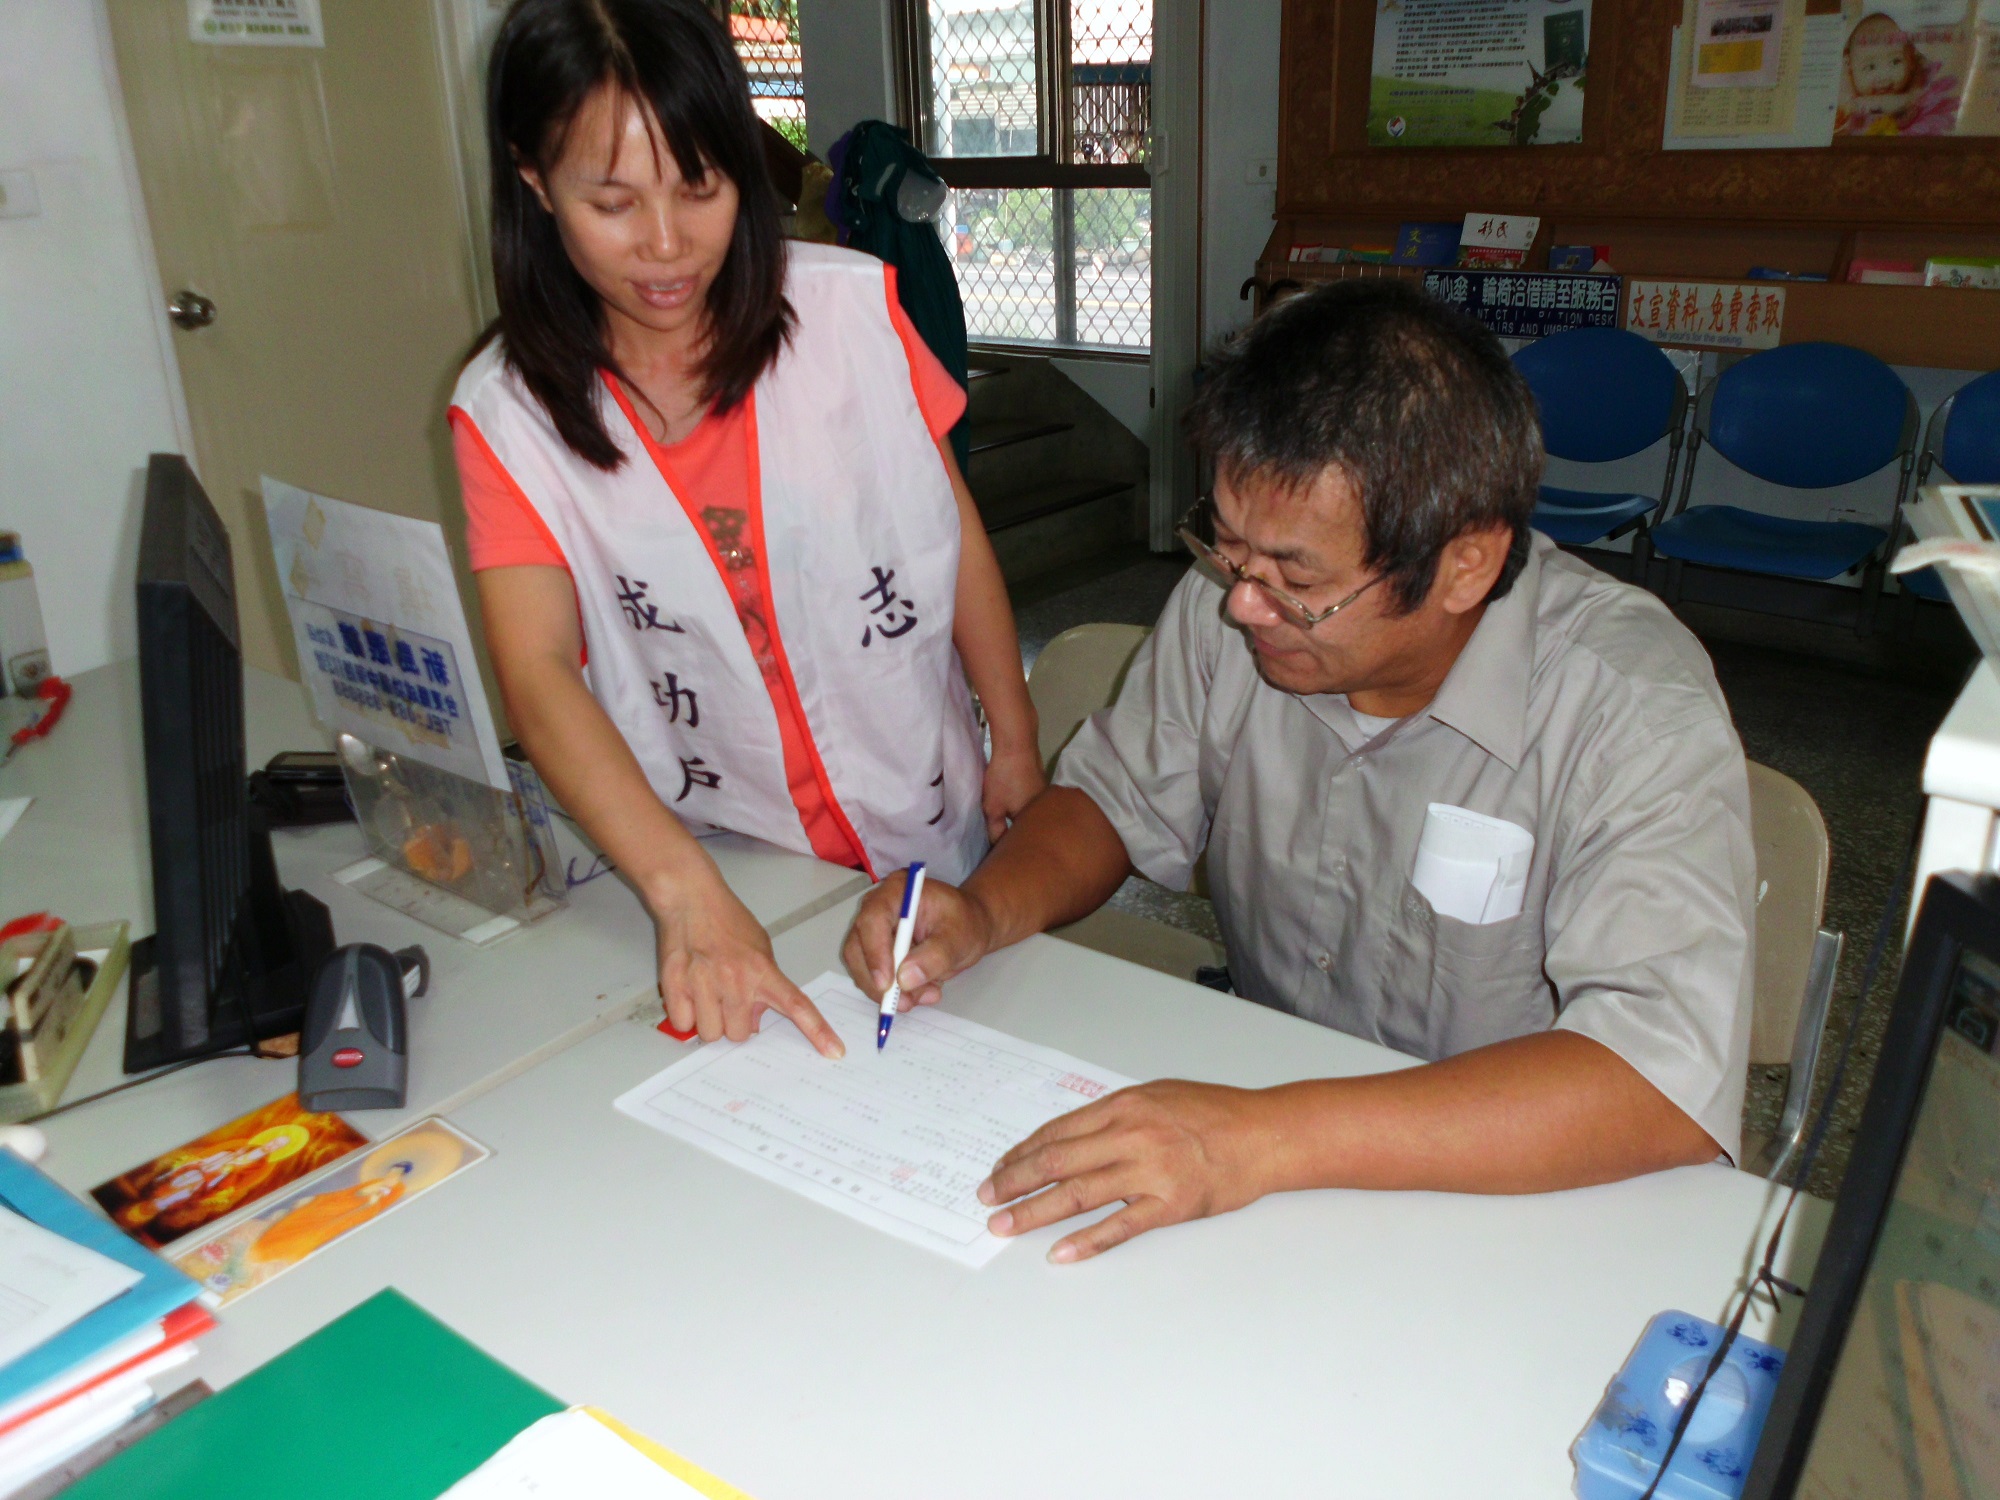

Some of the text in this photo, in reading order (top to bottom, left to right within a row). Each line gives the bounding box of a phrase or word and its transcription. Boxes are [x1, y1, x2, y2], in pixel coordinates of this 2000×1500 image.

[1519, 323, 1538, 335] AND
[1692, 331, 1703, 341] for
[1703, 332, 1716, 342] the
[1717, 333, 1742, 346] asking
